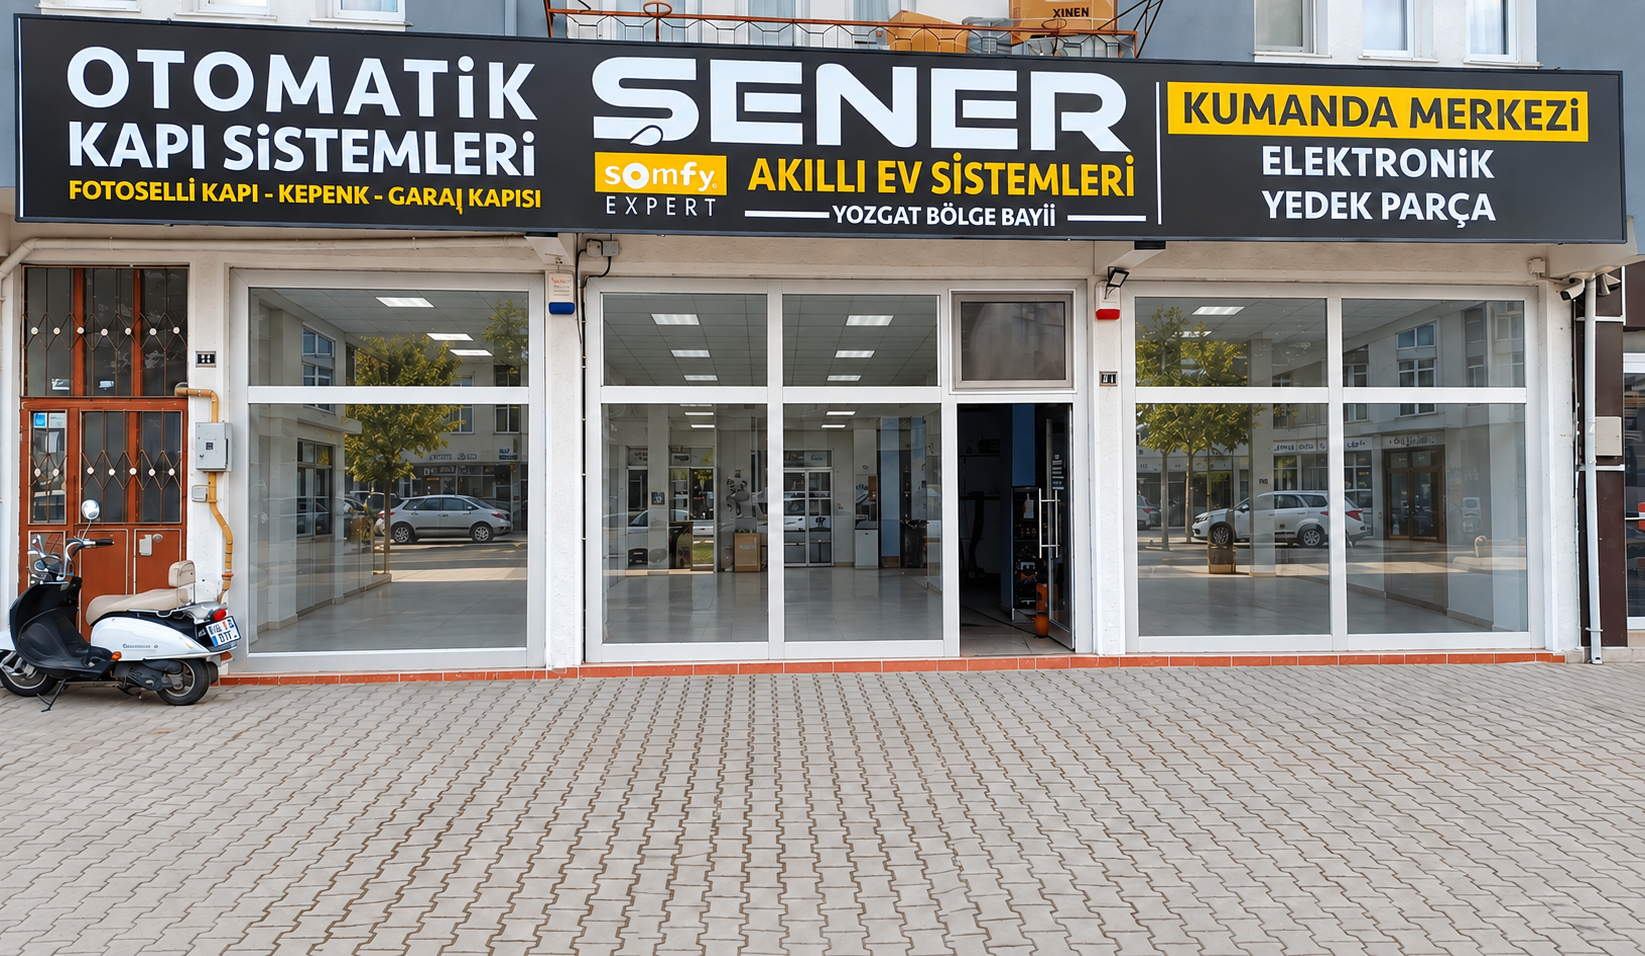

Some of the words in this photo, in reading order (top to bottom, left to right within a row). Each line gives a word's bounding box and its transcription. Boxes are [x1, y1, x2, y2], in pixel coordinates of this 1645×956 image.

[1052, 7, 1090, 18] XINEN
[1184, 91, 1398, 128] KUMANDA
[69, 121, 205, 169] KAPI
[747, 157, 866, 193] AKILLI
[878, 160, 923, 194] EV
[202, 182, 259, 203] KAPI
[278, 184, 370, 205] KEPENK
[469, 188, 541, 208] KAPISI
[606, 195, 716, 217] EXPERT
[1261, 190, 1374, 220] YEDEK
[1381, 193, 1497, 228] PARÇA
[832, 205, 922, 225] YOZGAT
[926, 202, 996, 226] BÖLGE
